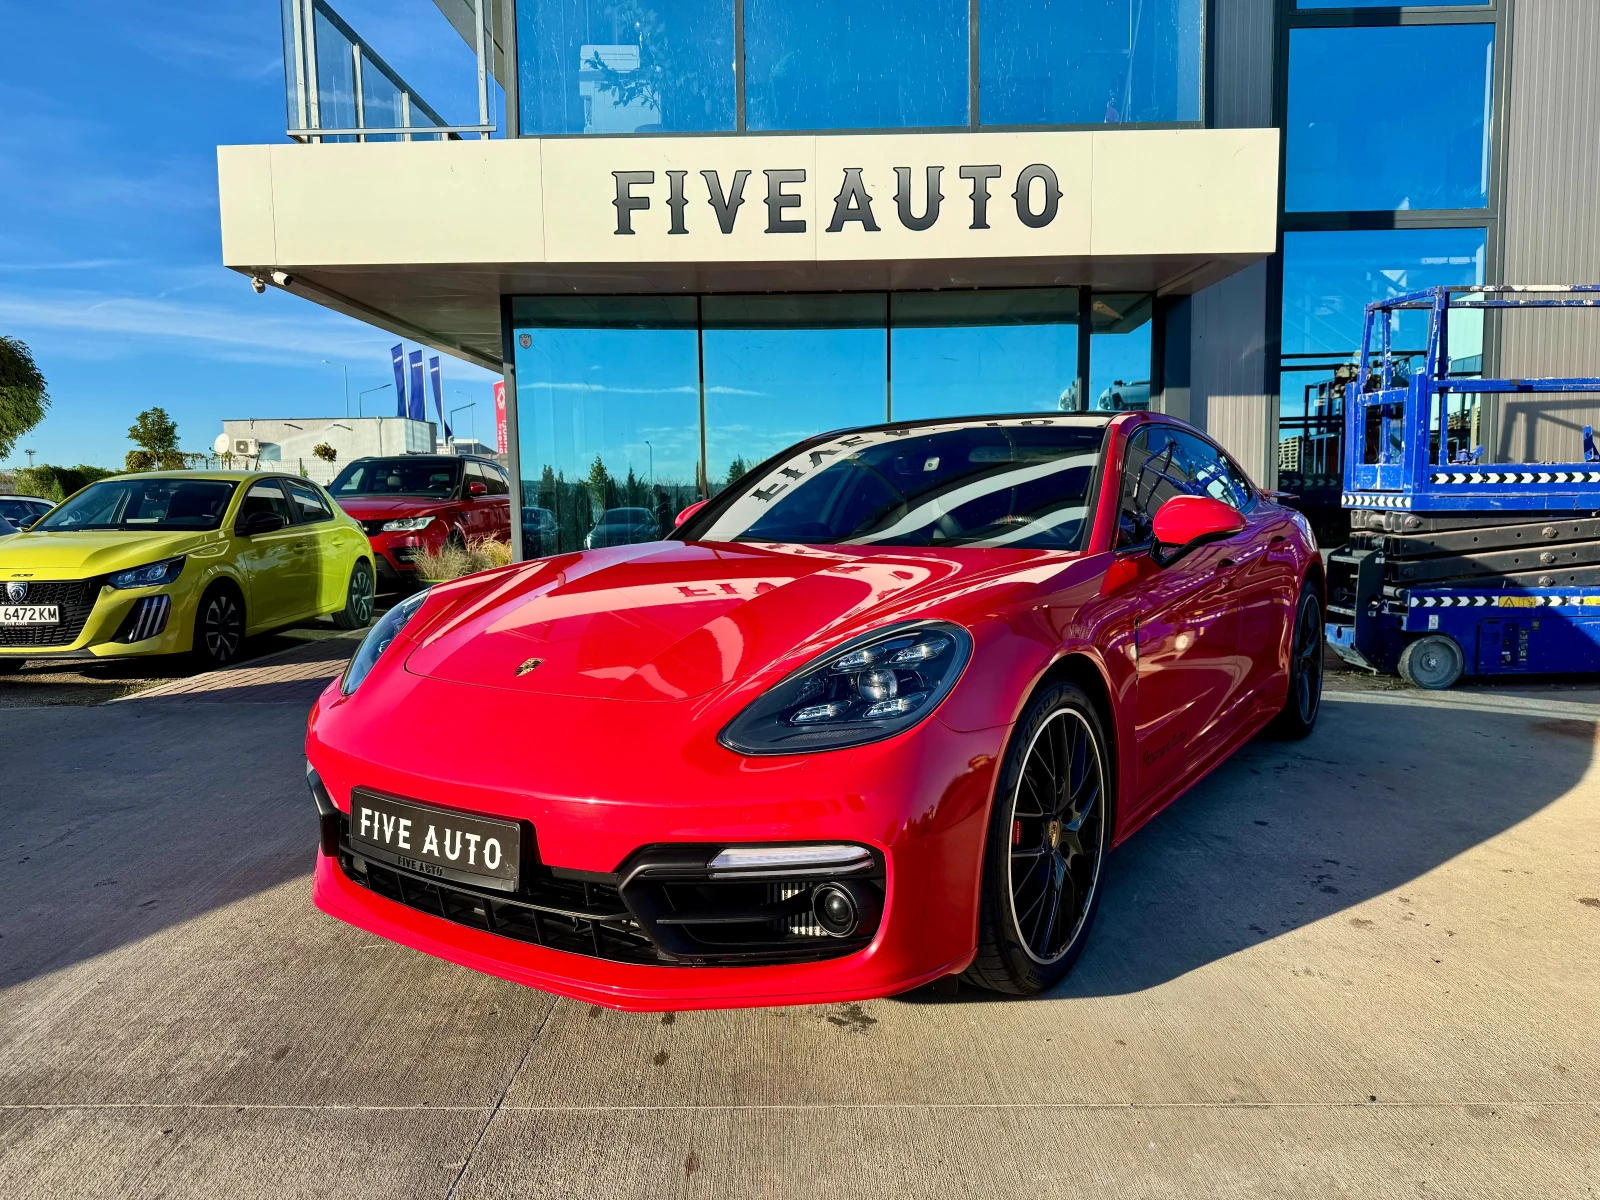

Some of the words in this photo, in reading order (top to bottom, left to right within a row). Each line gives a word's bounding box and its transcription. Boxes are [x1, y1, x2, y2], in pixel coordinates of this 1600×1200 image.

[360, 807, 412, 850] FIVE
[421, 824, 503, 870] AUTO
[397, 856, 417, 870] FIVE
[419, 861, 443, 877] AUTO
